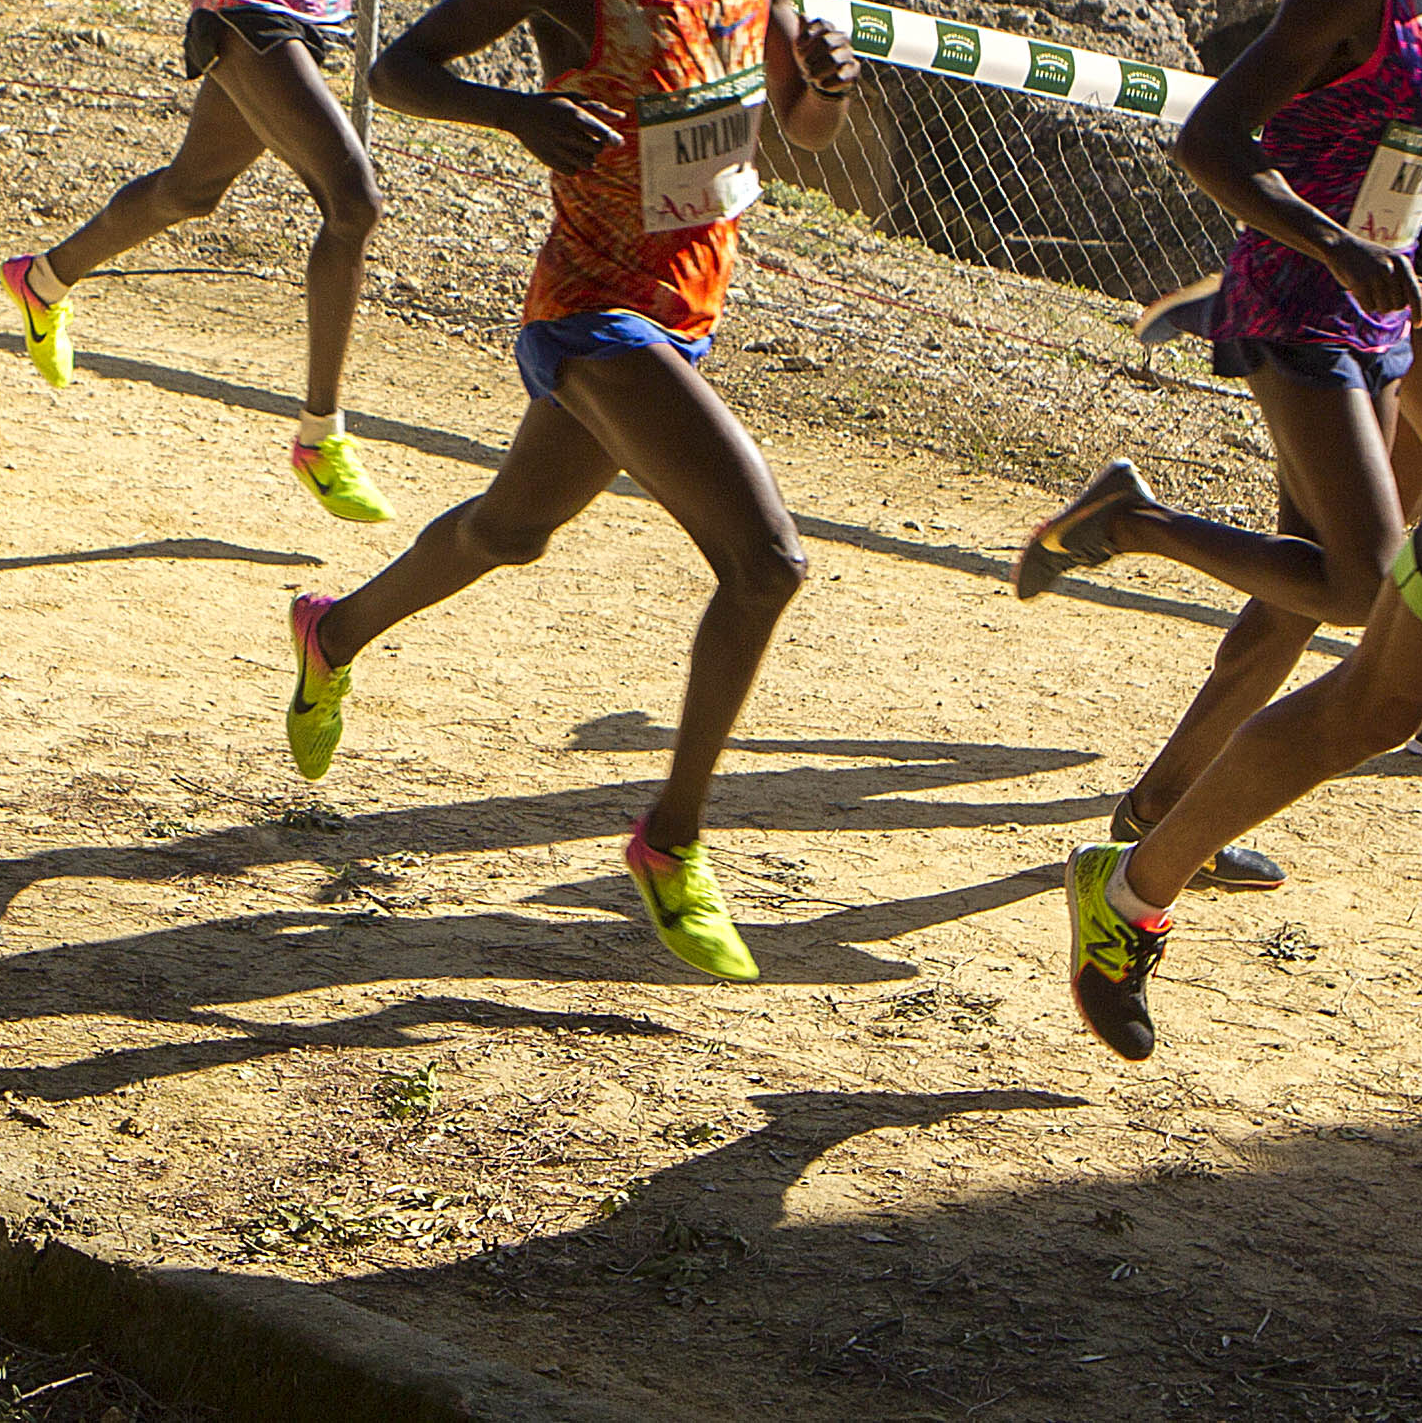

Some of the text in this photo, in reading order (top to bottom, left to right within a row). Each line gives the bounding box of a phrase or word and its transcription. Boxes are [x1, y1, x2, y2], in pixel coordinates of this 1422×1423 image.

[857, 30, 887, 44] SEVILLA
[942, 48, 974, 63] SEVILLA
[1035, 69, 1066, 83] SEVILLA
[1126, 87, 1158, 102] SEVILLA
